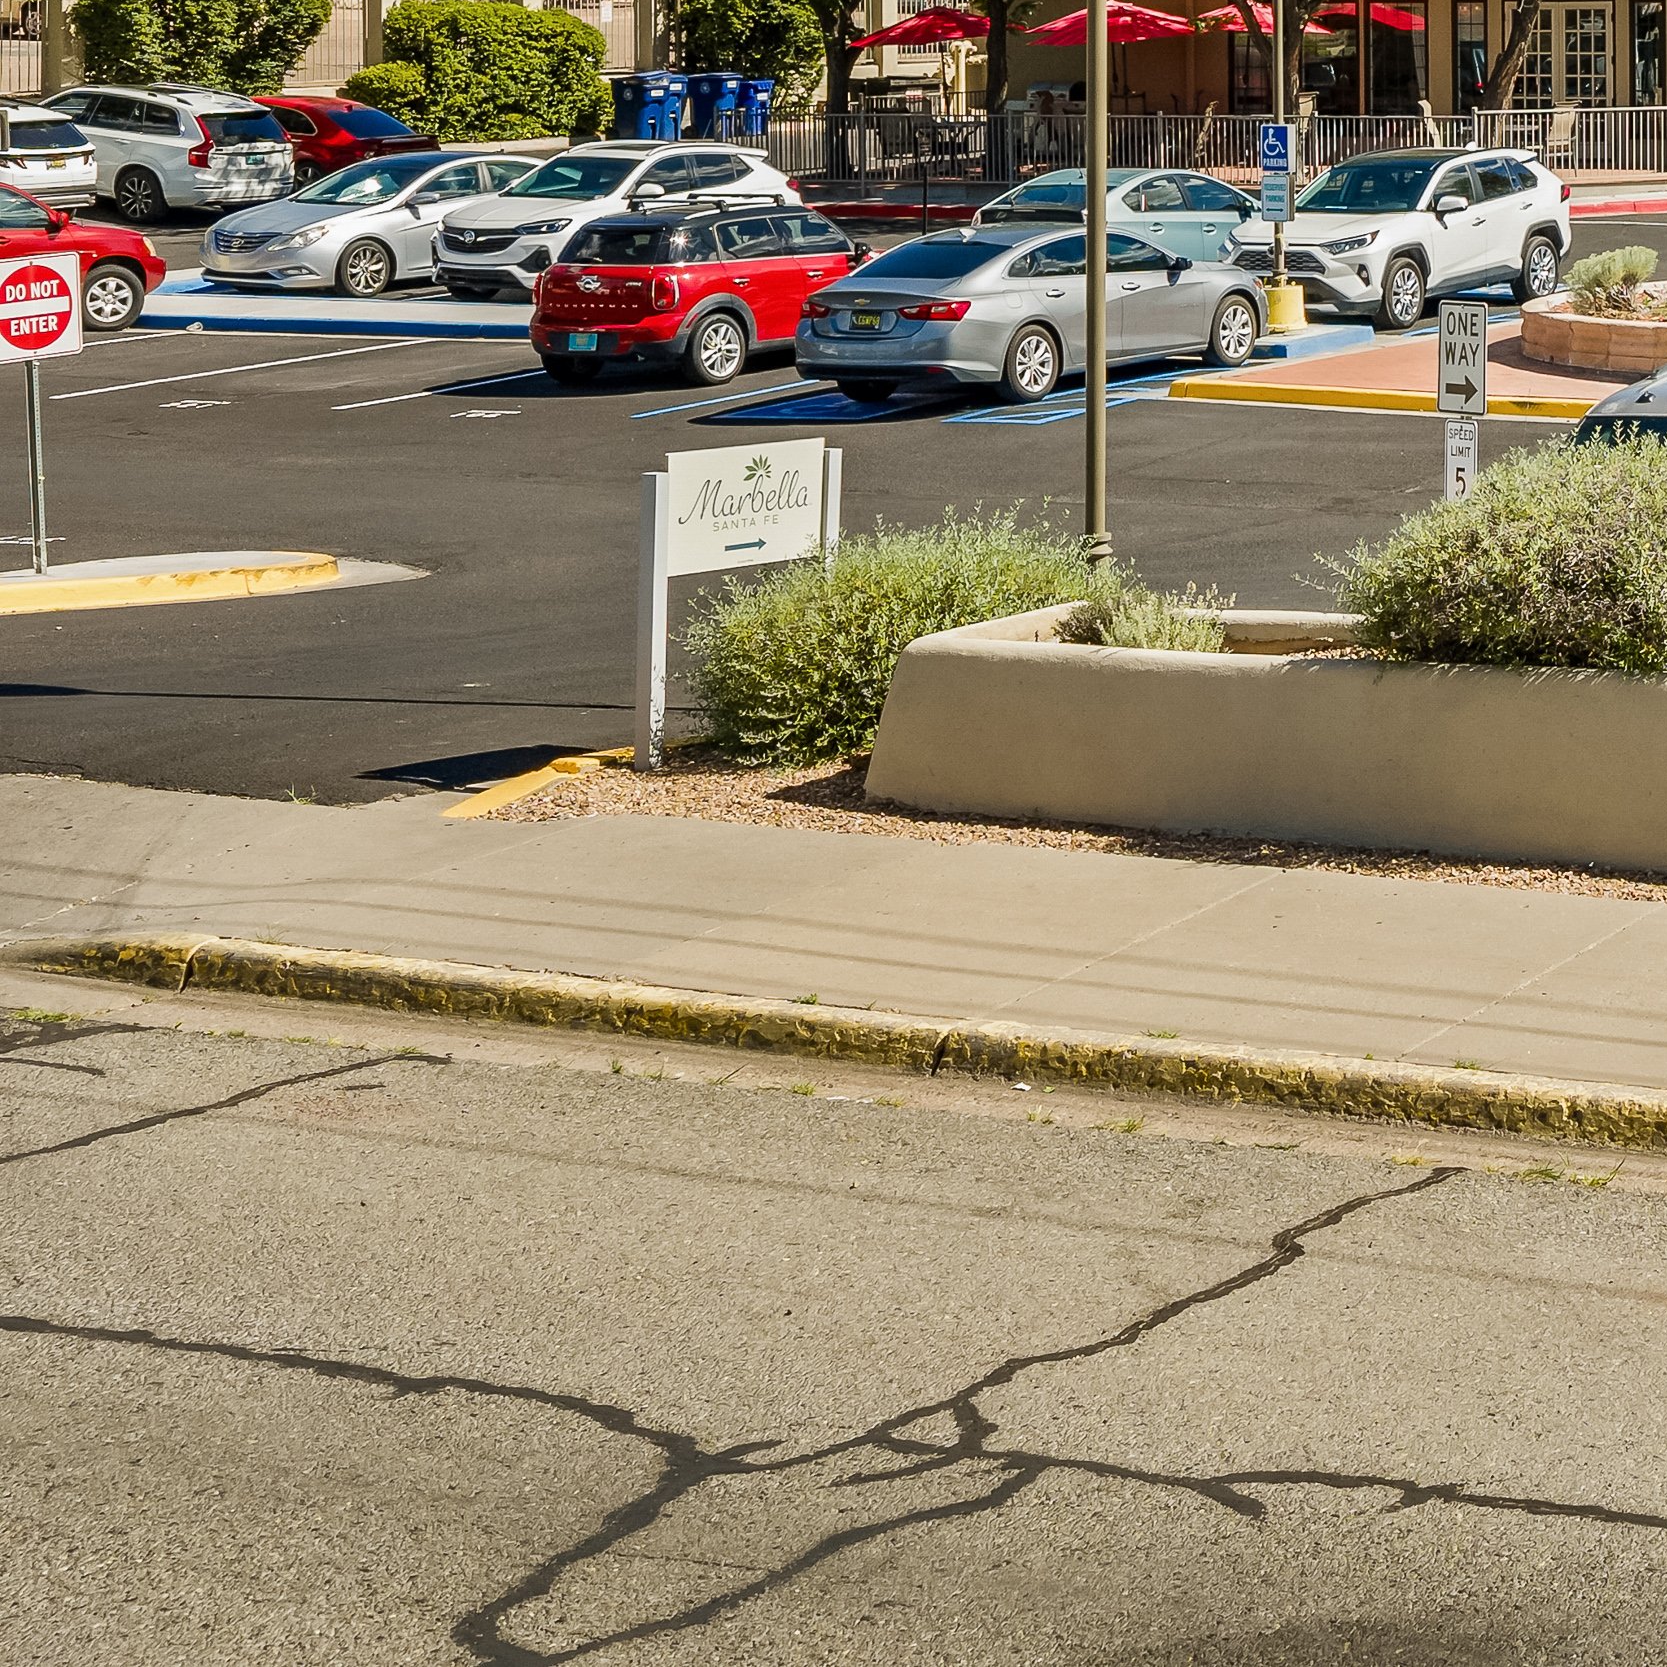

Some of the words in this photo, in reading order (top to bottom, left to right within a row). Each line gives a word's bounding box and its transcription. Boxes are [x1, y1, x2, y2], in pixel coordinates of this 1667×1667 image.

[1263, 157, 1287, 167] PARKING
[5, 283, 27, 302] DO
[30, 279, 60, 299] NOT
[10, 315, 58, 337] ENTER
[1446, 311, 1479, 337] ONE
[1444, 341, 1480, 367] WAY
[1448, 426, 1474, 441] SPEED
[1450, 446, 1472, 458] LIMIT
[1455, 467, 1466, 496] 5
[678, 469, 809, 525] Marbella
[712, 516, 757, 532] SANTA
[763, 514, 780, 525] FE
